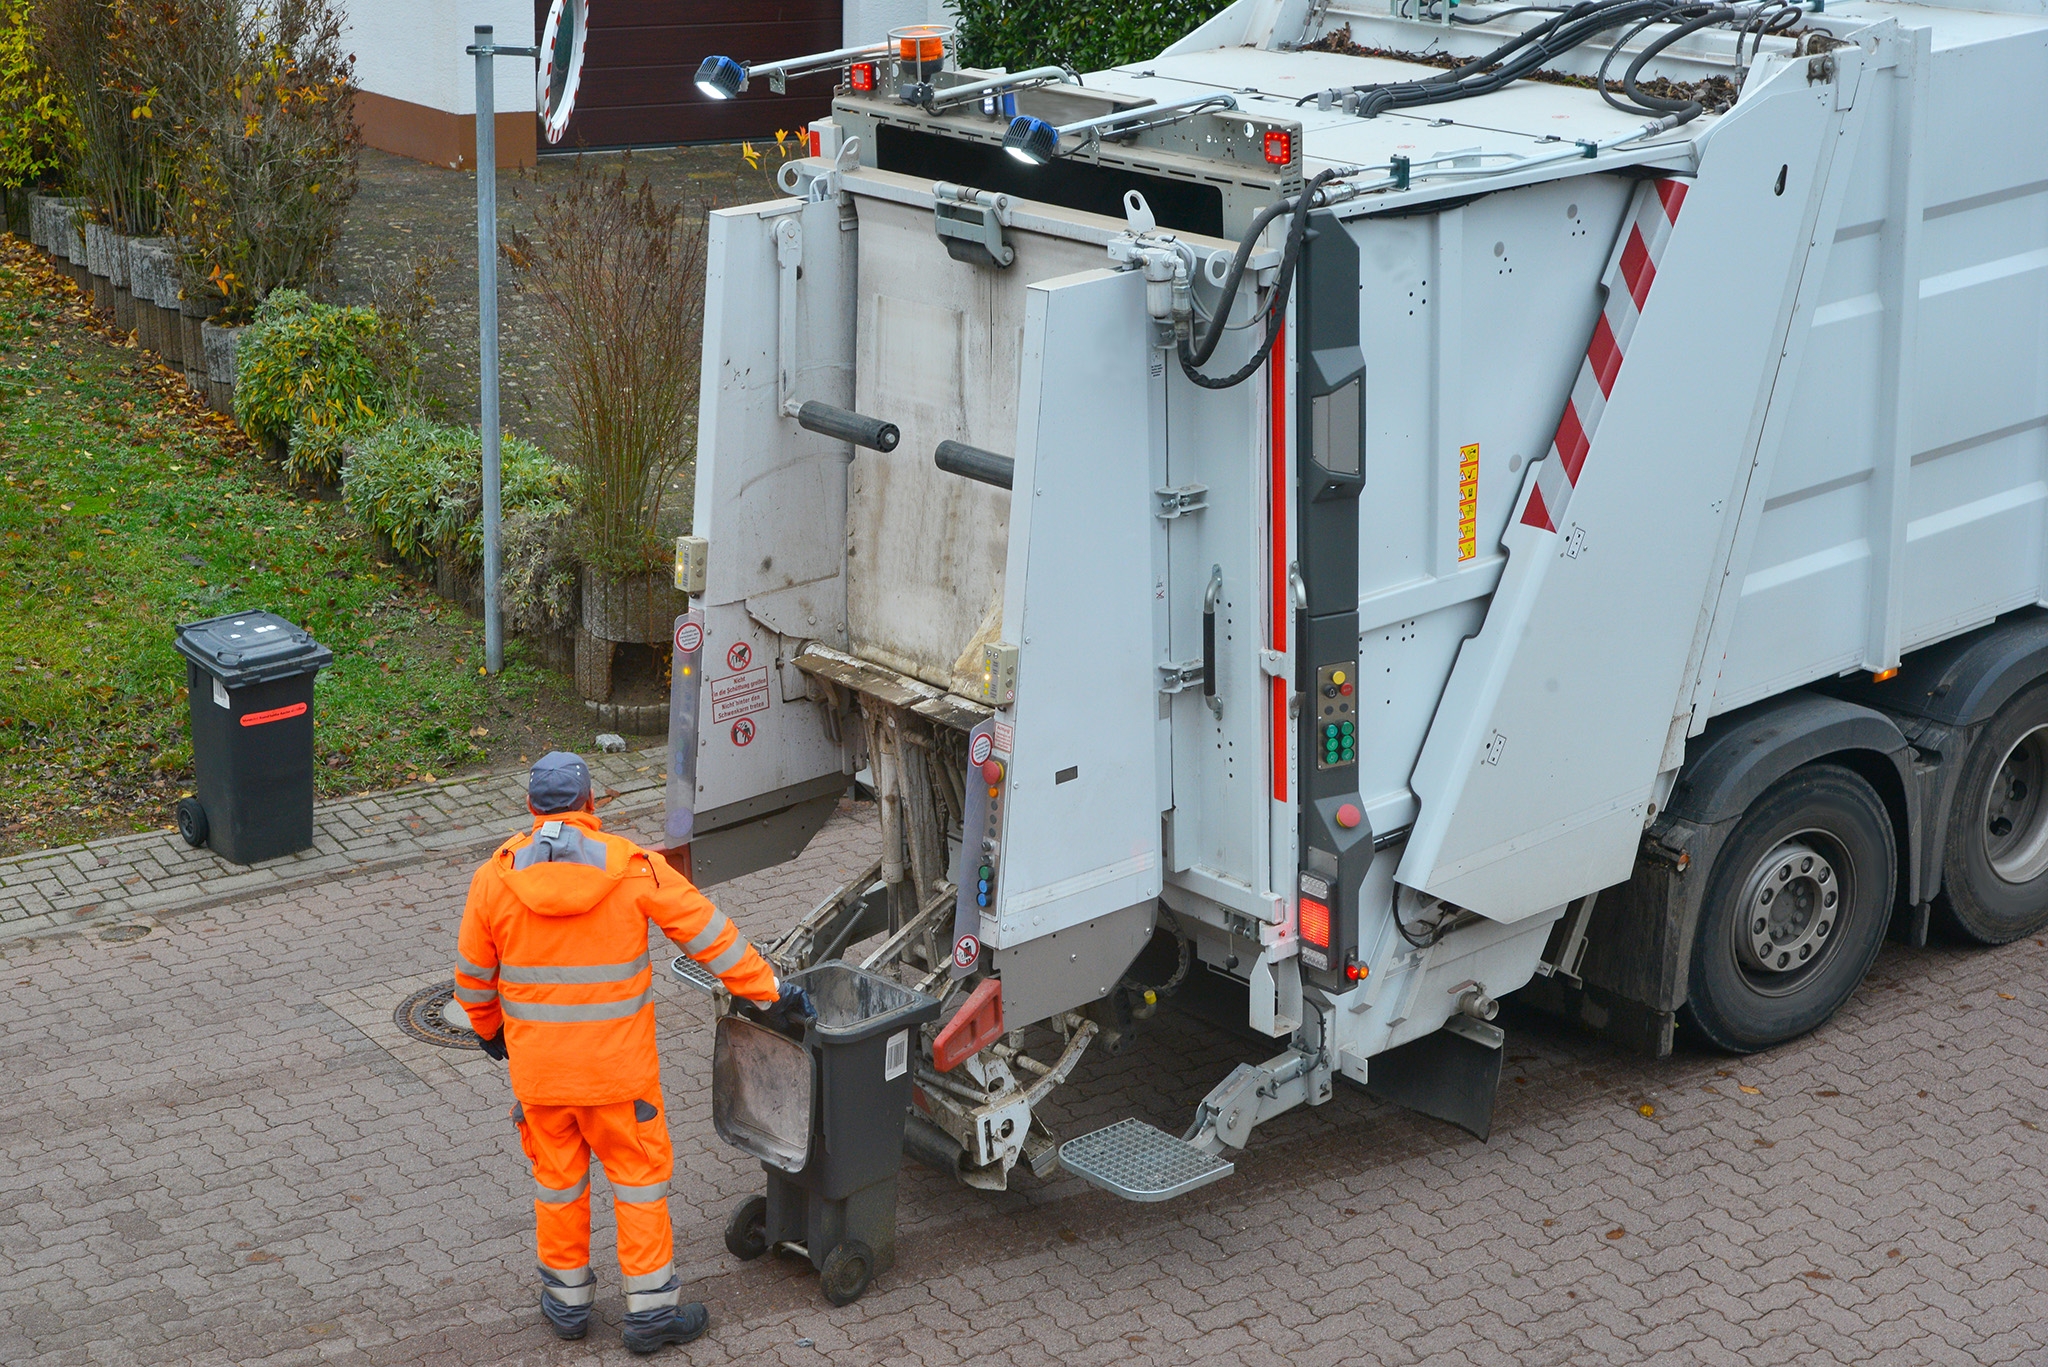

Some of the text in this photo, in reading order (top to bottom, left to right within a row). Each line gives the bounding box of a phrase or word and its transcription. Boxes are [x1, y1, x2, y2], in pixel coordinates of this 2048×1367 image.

[733, 676, 746, 684] Nicht
[721, 702, 735, 710] Nicht
[735, 698, 750, 706] hinter
[718, 702, 764, 719] Schwenkarm treten
